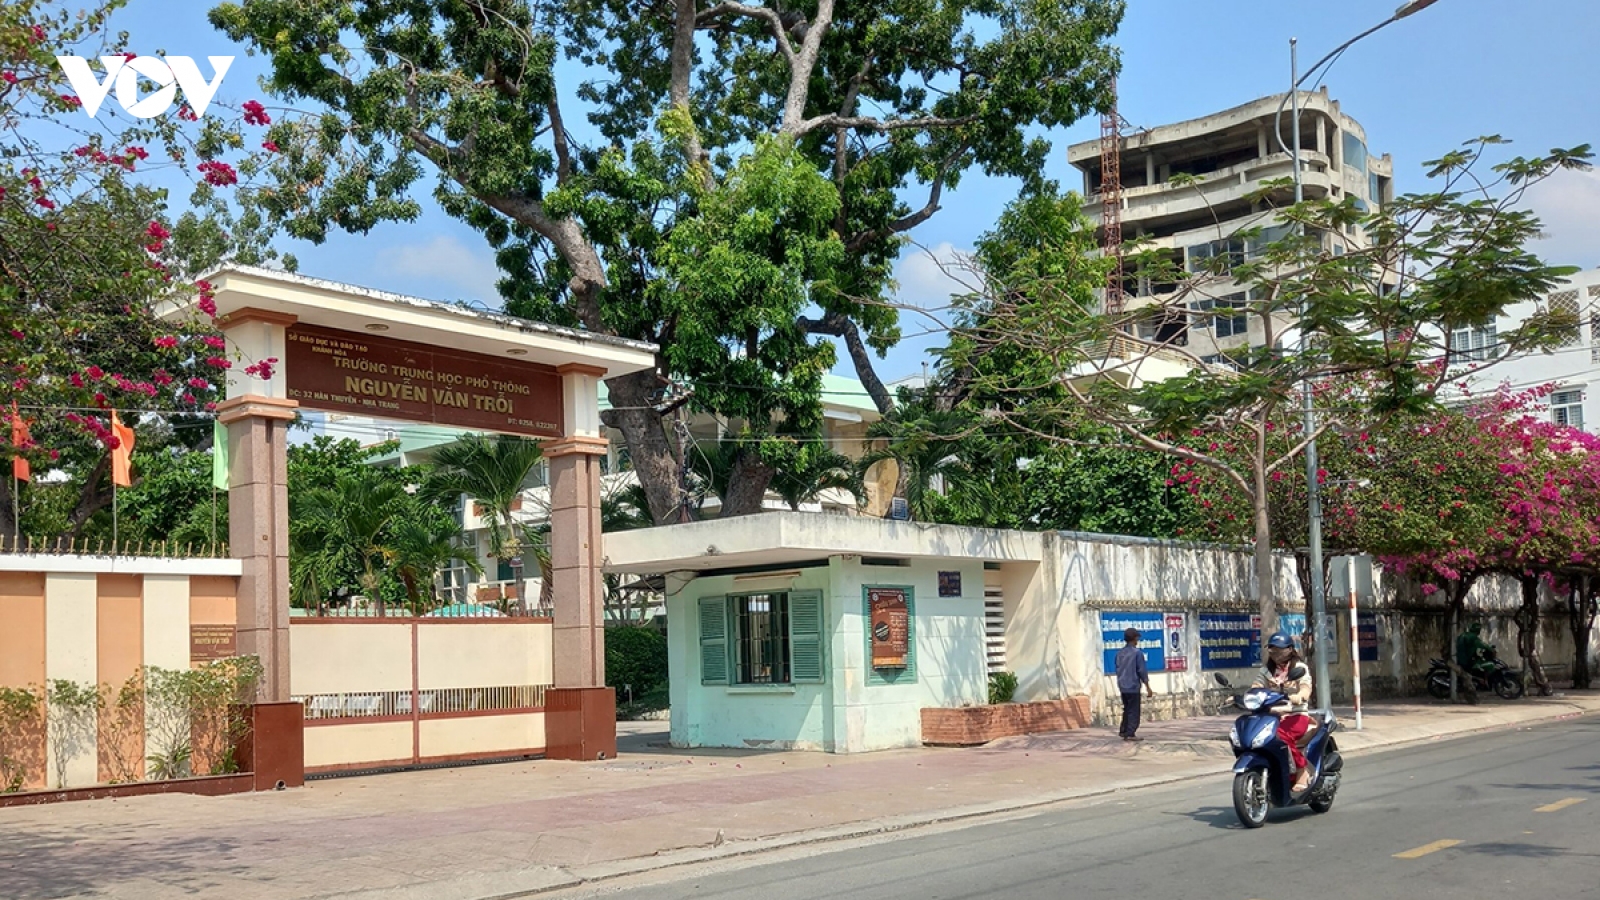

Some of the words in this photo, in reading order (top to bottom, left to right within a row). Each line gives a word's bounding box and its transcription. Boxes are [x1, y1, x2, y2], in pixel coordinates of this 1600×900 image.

[300, 335, 314, 344] GIÁO
[330, 340, 339, 348] VÀ
[312, 346, 332, 354] KHÁNH
[332, 356, 387, 373] TRƯỜNG
[391, 365, 433, 380] TRUNG
[437, 372, 462, 386] HỌC
[465, 374, 489, 388] PHỔ
[491, 380, 530, 395] THÔNG
[303, 390, 313, 398] 32
[314, 391, 329, 400] HÀN
[331, 394, 357, 404] THUYÊN
[363, 399, 377, 408] NHA
[378, 401, 400, 409] TRANG
[345, 376, 427, 403] NGUYỄN
[432, 386, 469, 409] VĂN
[472, 392, 513, 414] TRỖI
